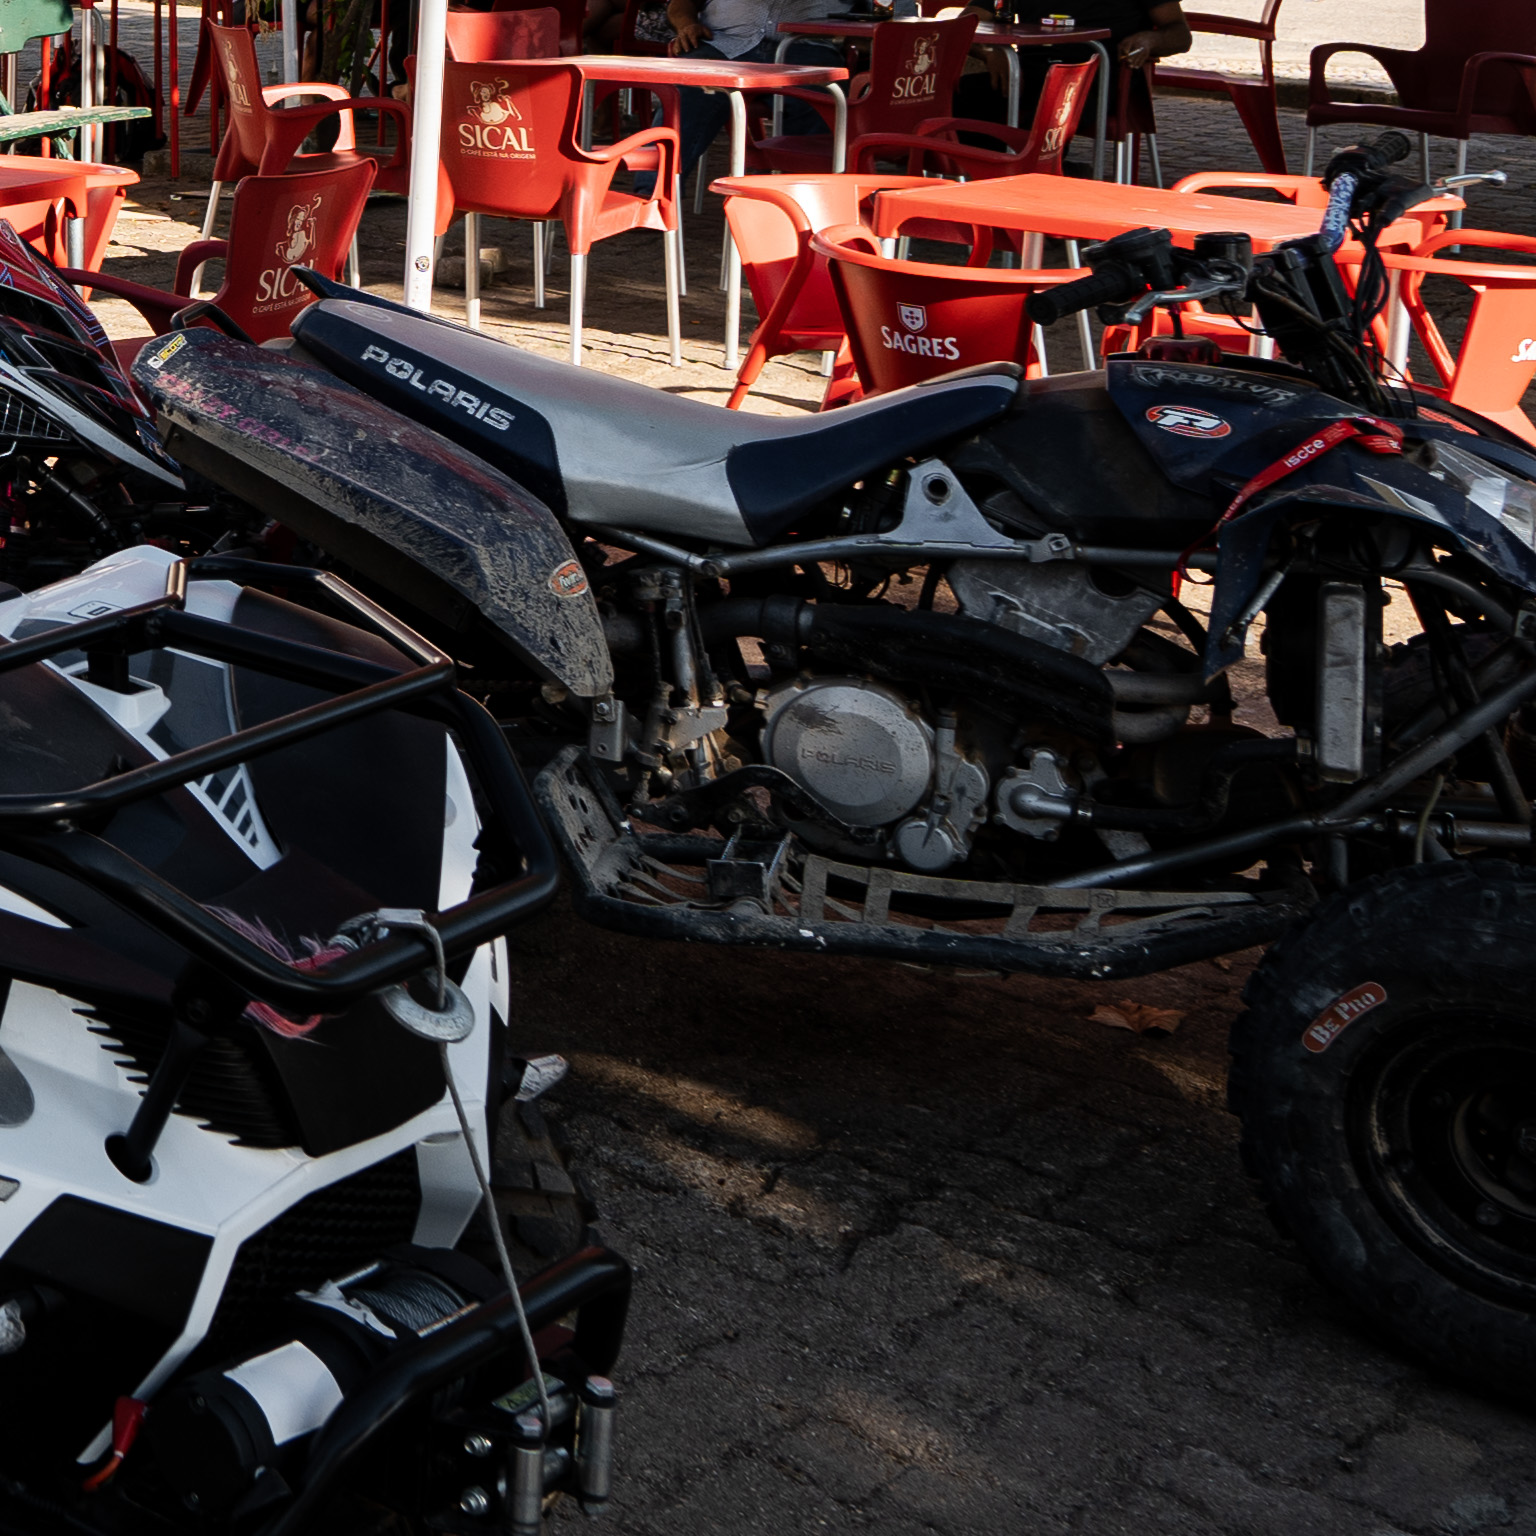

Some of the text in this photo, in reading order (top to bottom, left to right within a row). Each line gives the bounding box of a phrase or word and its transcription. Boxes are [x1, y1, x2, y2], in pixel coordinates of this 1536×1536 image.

[892, 73, 936, 98] SICAL
[458, 123, 535, 152] SICAL
[881, 325, 960, 360] SAGRES
[360, 344, 516, 431] POLARIS
